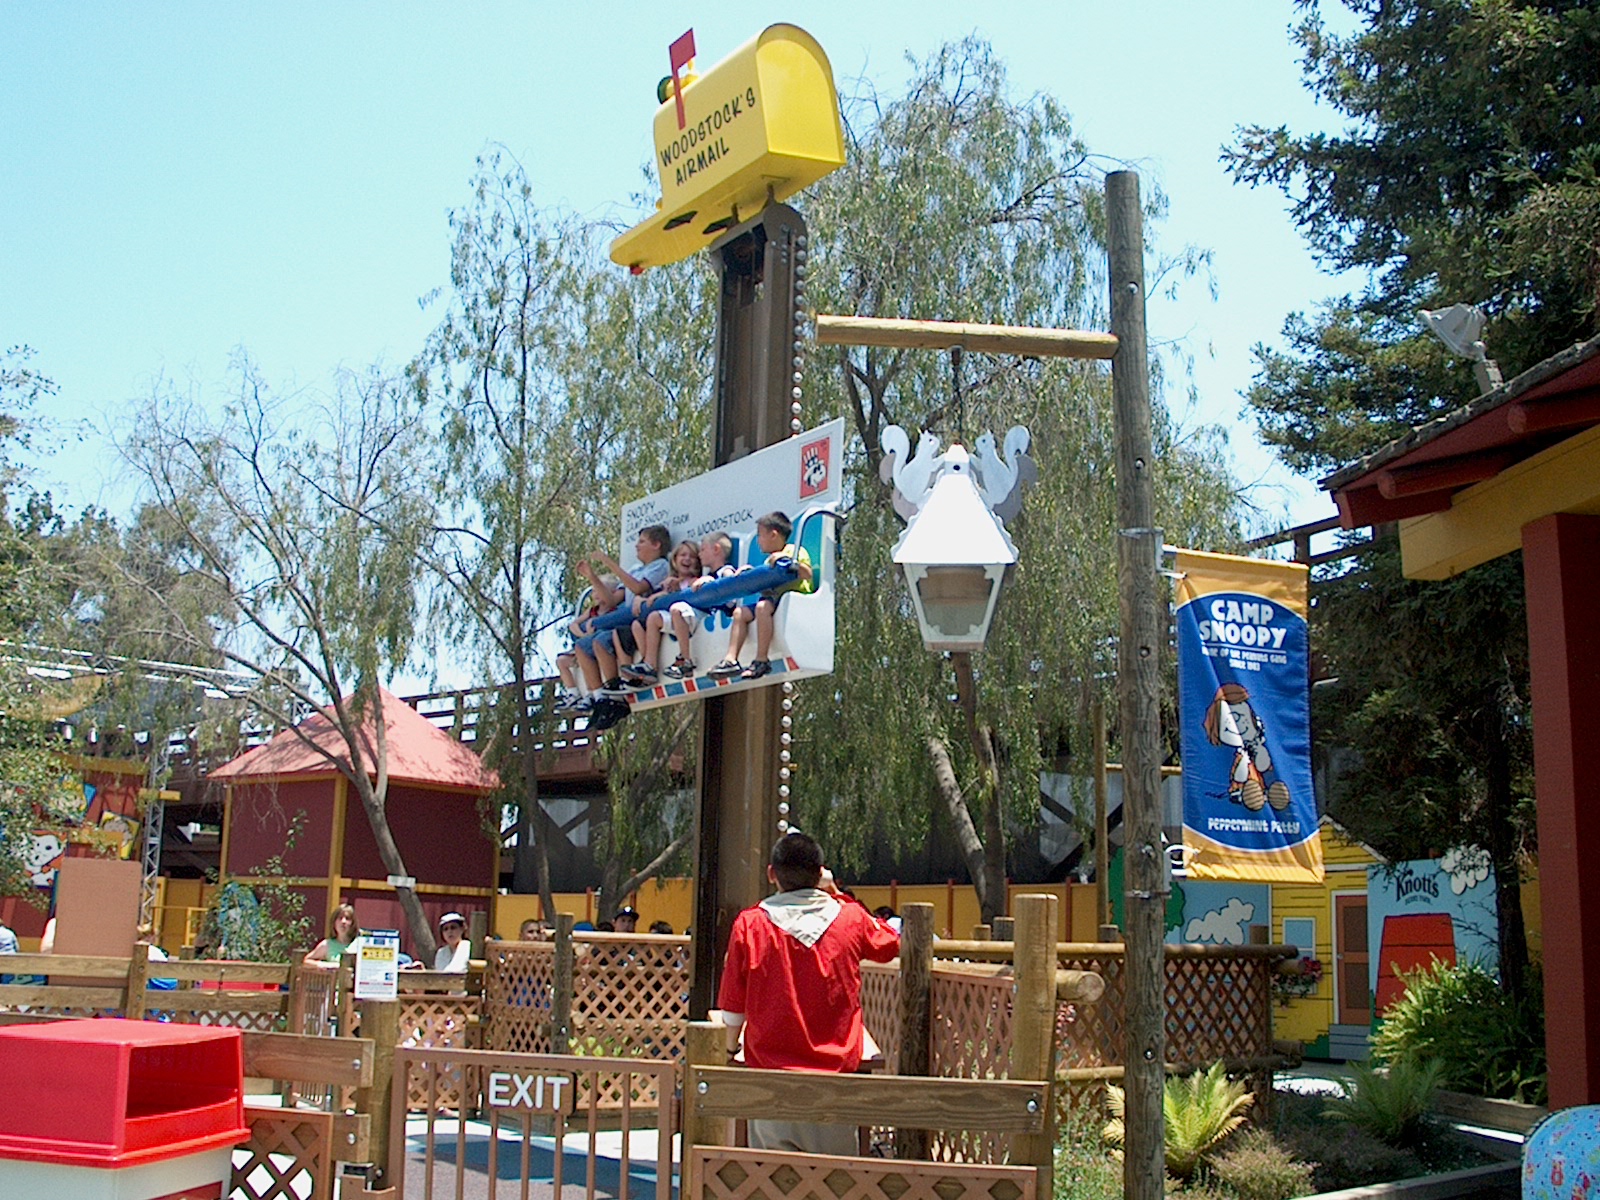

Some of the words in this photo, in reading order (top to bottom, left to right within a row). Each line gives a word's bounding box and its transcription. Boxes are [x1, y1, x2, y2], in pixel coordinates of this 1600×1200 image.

[661, 87, 756, 167] WOODSTOCK'S
[676, 137, 730, 187] AIRMAIL
[627, 501, 656, 518] SNOOPY
[697, 508, 754, 536] WOODSTOCK
[1211, 599, 1274, 625] CAMP
[1200, 620, 1287, 649] SNOOPY
[1396, 869, 1439, 902] Knott's
[489, 1072, 570, 1110] EXIT
